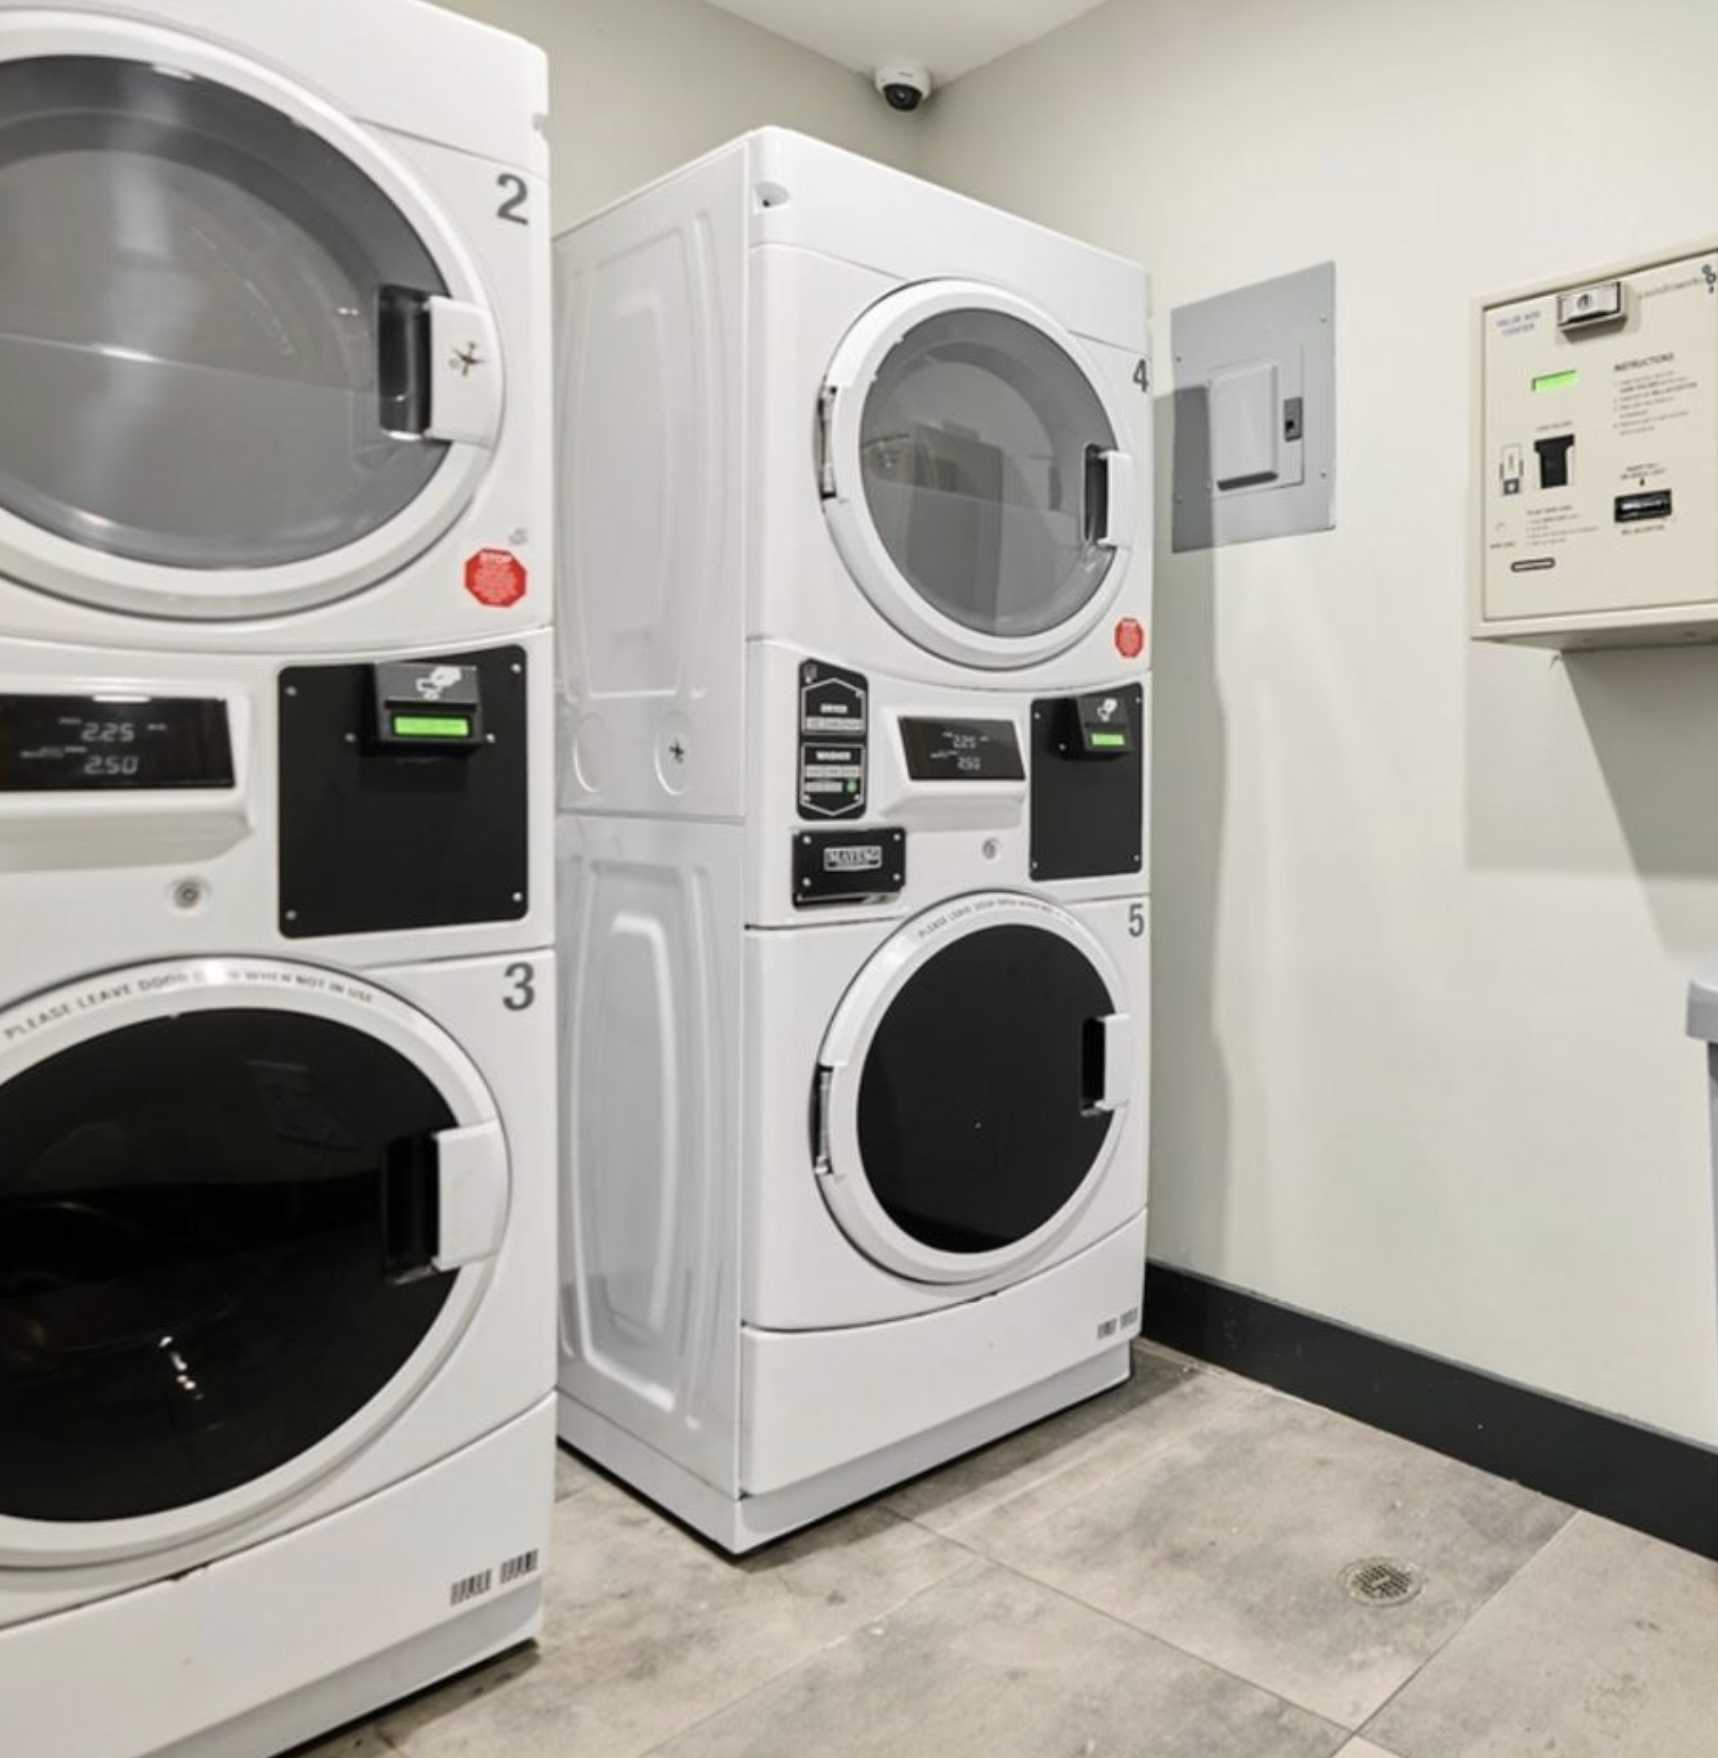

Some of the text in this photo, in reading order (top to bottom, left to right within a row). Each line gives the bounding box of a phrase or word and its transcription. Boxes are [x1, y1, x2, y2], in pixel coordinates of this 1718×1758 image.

[497, 172, 528, 225] 2
[1133, 359, 1148, 392] 4
[1128, 903, 1145, 938] 5
[4, 1002, 71, 1040] PLEASE
[76, 982, 131, 1009] LEAVE
[138, 972, 188, 991] DOOR
[244, 970, 294, 983] WHEN
[296, 972, 326, 989] NOT
[328, 981, 345, 994] IN
[346, 986, 373, 1003] USE
[503, 962, 535, 1011] 3
